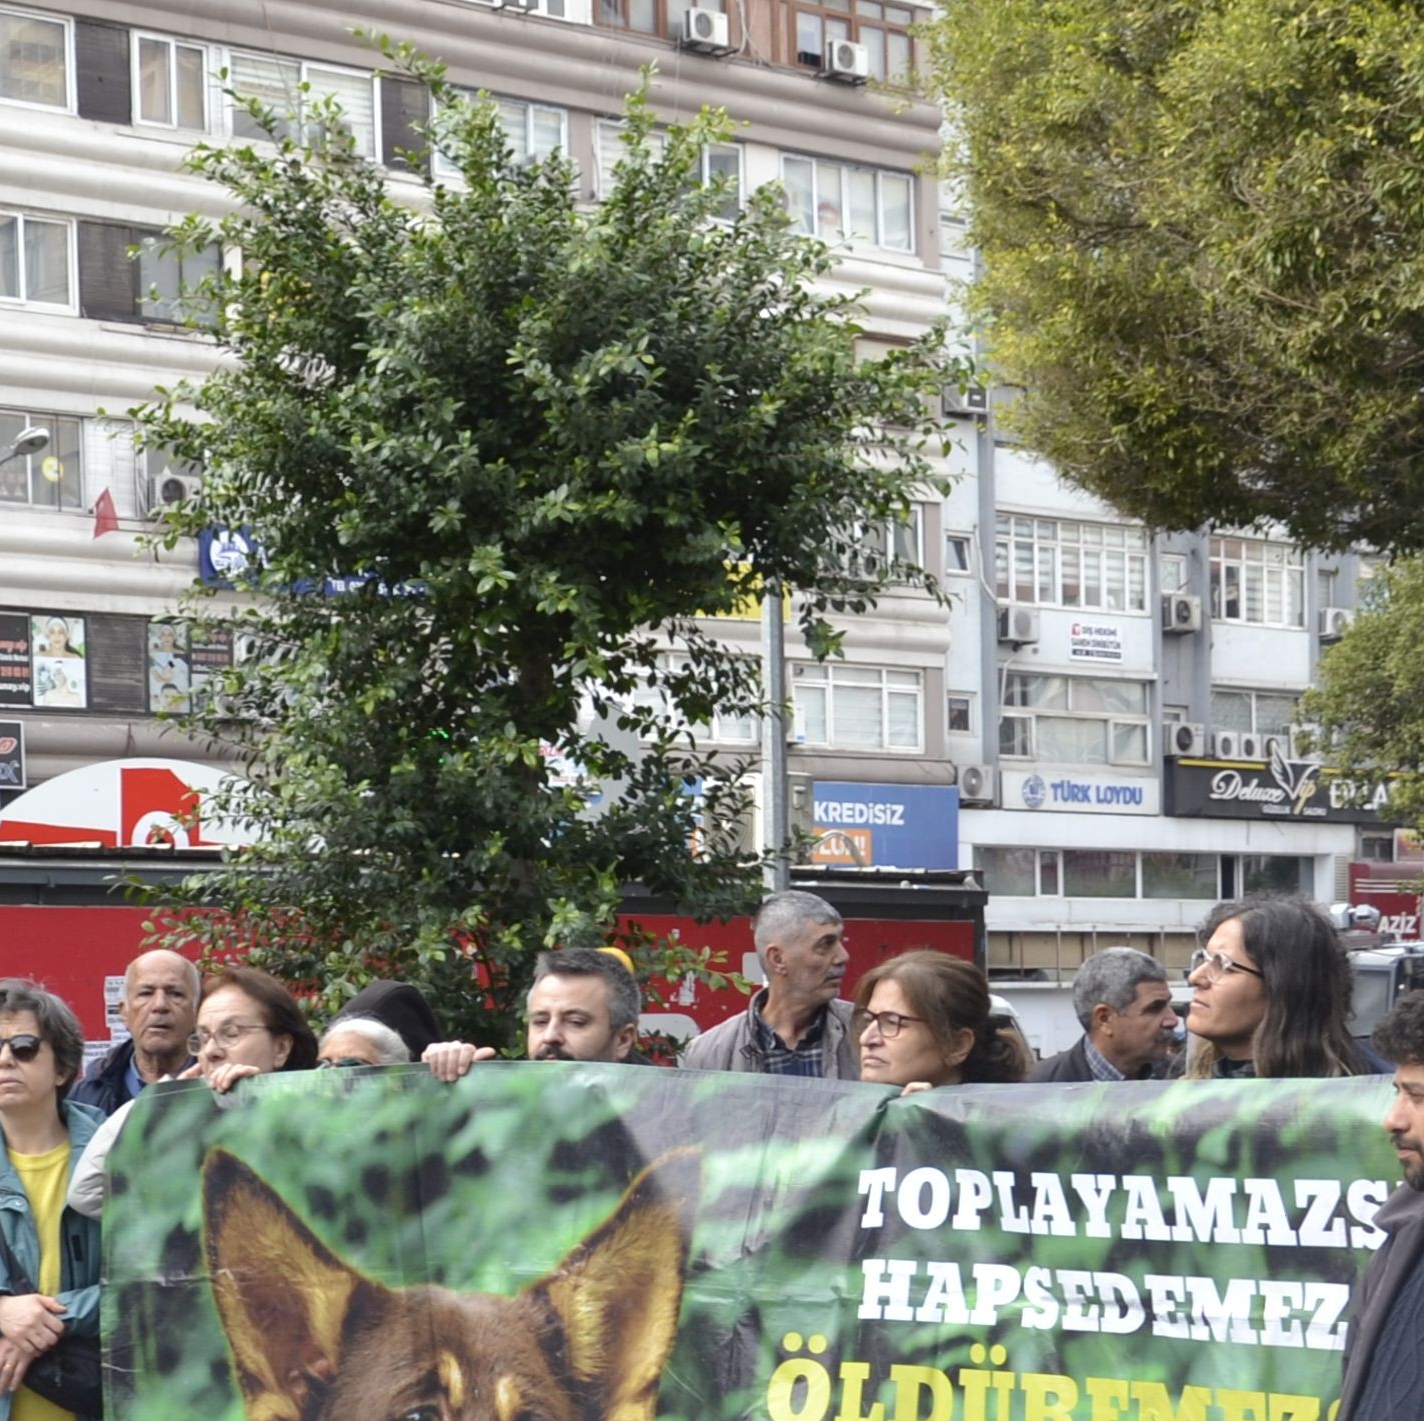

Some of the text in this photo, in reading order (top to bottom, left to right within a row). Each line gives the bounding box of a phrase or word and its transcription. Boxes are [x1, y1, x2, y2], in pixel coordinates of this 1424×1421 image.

[1051, 779, 1091, 803] TÜRK
[1096, 785, 1143, 805] LOYDU
[1209, 770, 1285, 803] Deluxe
